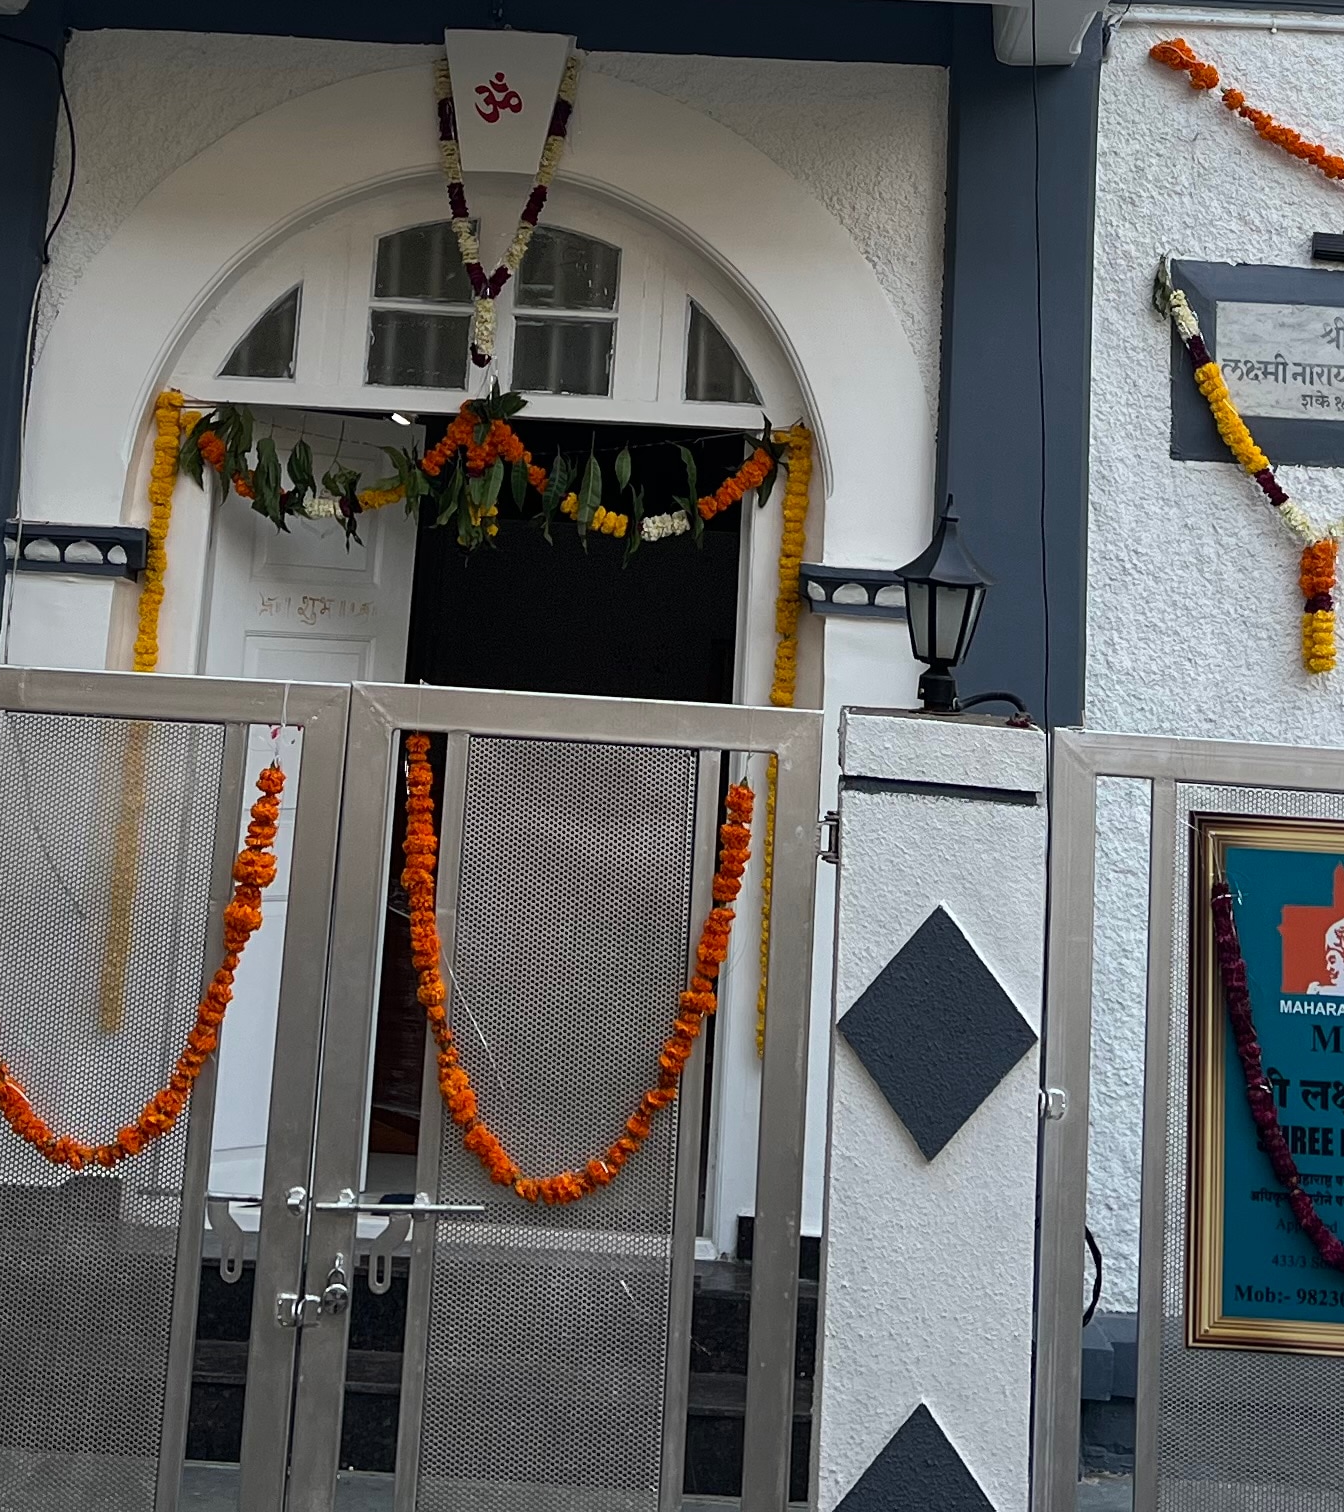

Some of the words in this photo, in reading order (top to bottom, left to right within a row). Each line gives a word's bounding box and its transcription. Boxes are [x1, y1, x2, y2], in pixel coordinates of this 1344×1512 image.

[1222, 354, 1289, 385] लक्ष्मी
[1301, 390, 1330, 410] शके
[1233, 1284, 1291, 1304] Mob:-
